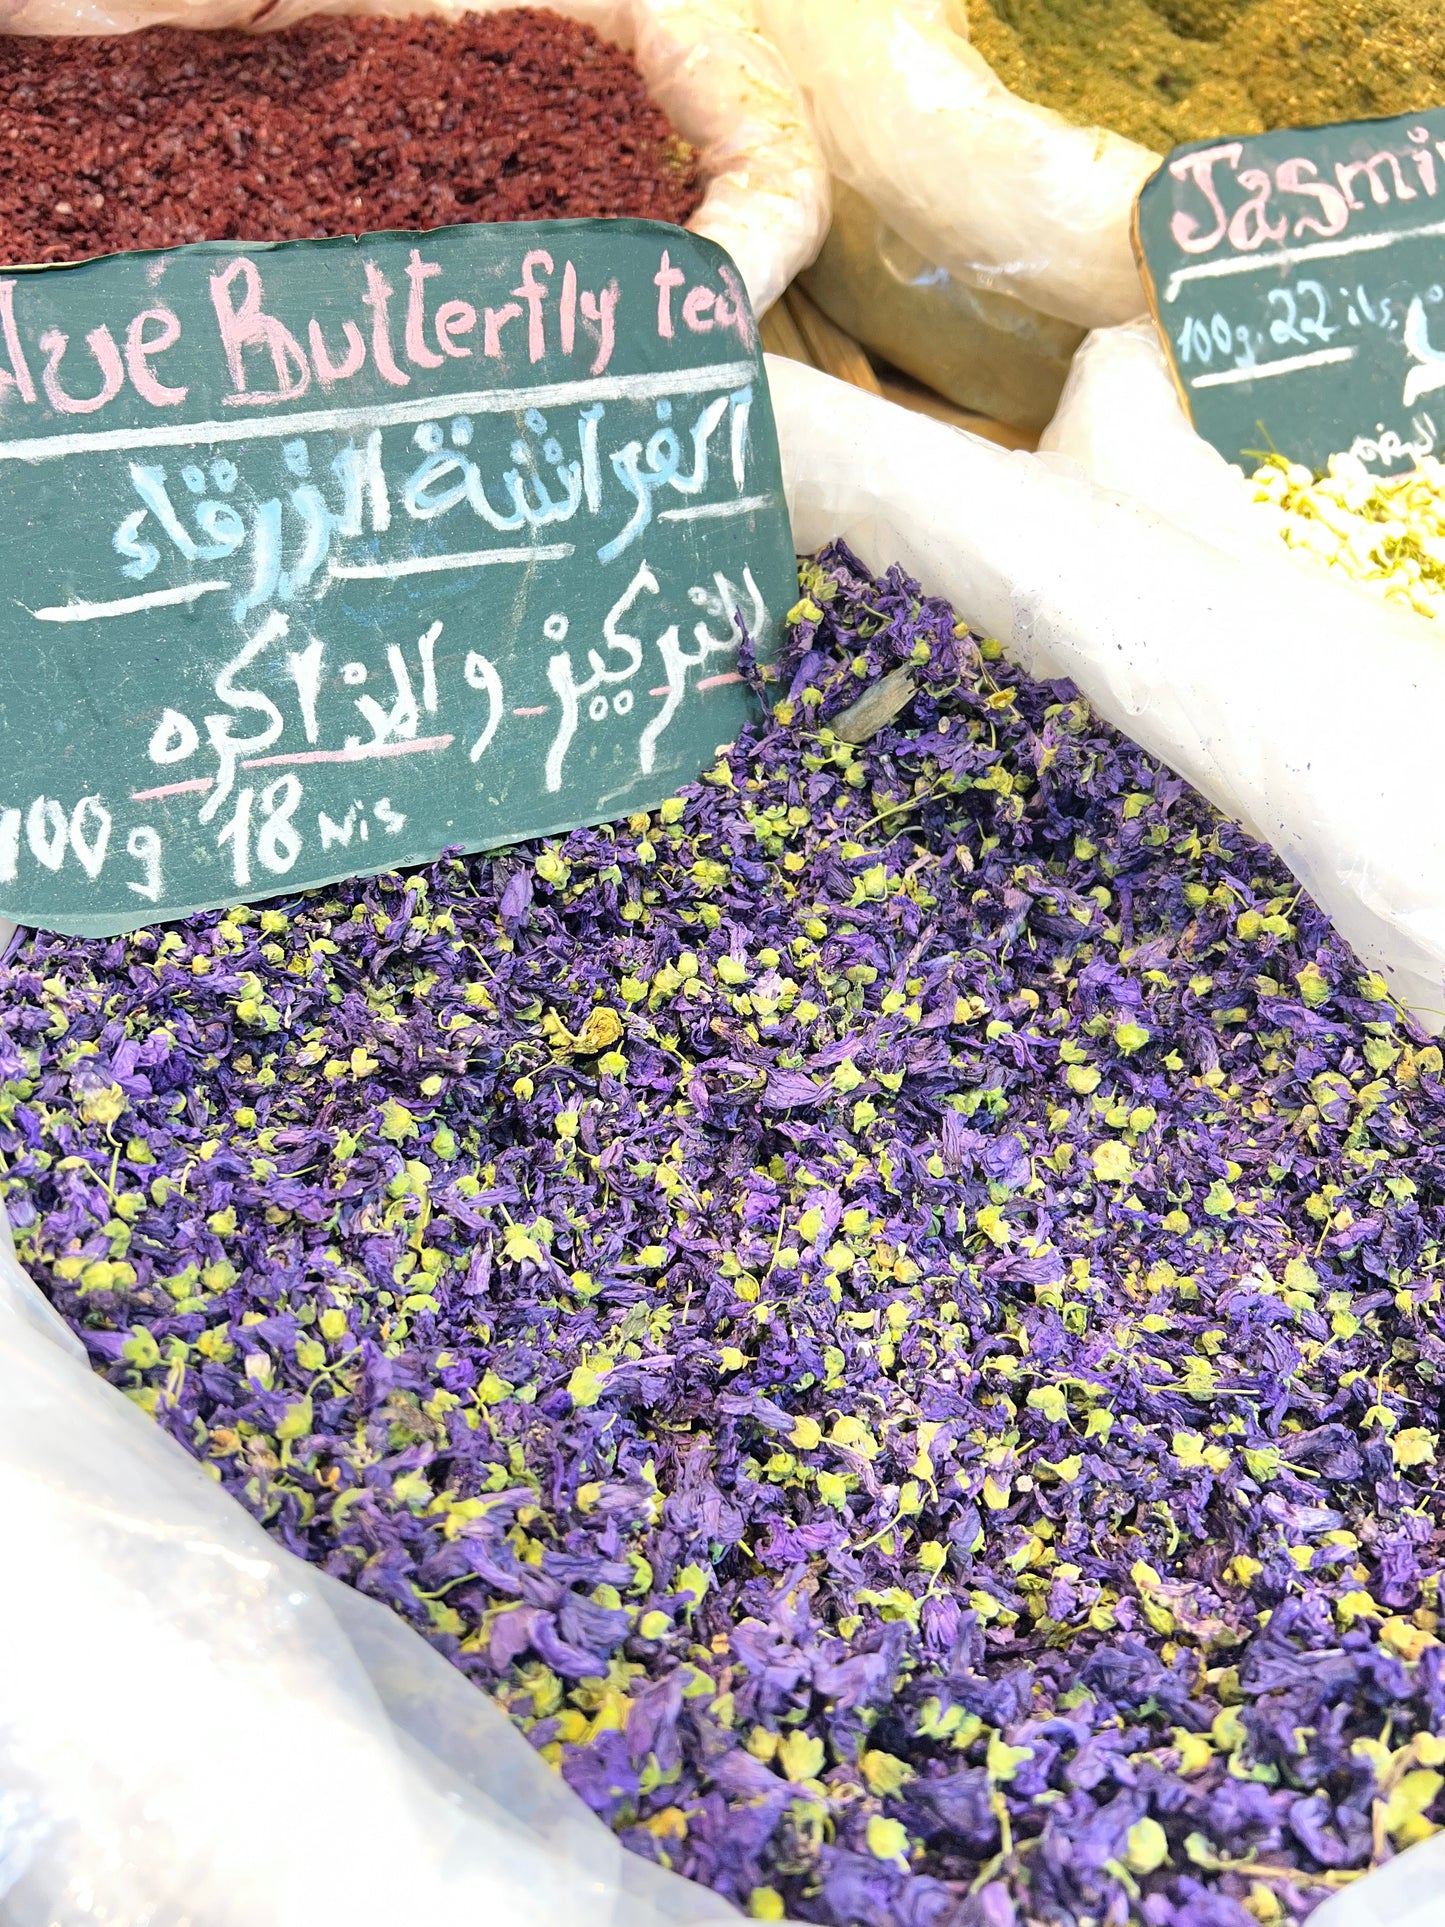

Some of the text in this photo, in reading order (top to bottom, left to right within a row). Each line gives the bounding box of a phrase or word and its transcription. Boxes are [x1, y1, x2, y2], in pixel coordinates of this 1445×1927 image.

[1168, 126, 1445, 254] Jasmi
[0, 249, 756, 414] lue Butterfly tea
[1268, 280, 1341, 346] 22
[403, 385, 754, 565] الفراشة
[217, 773, 302, 888] 18
